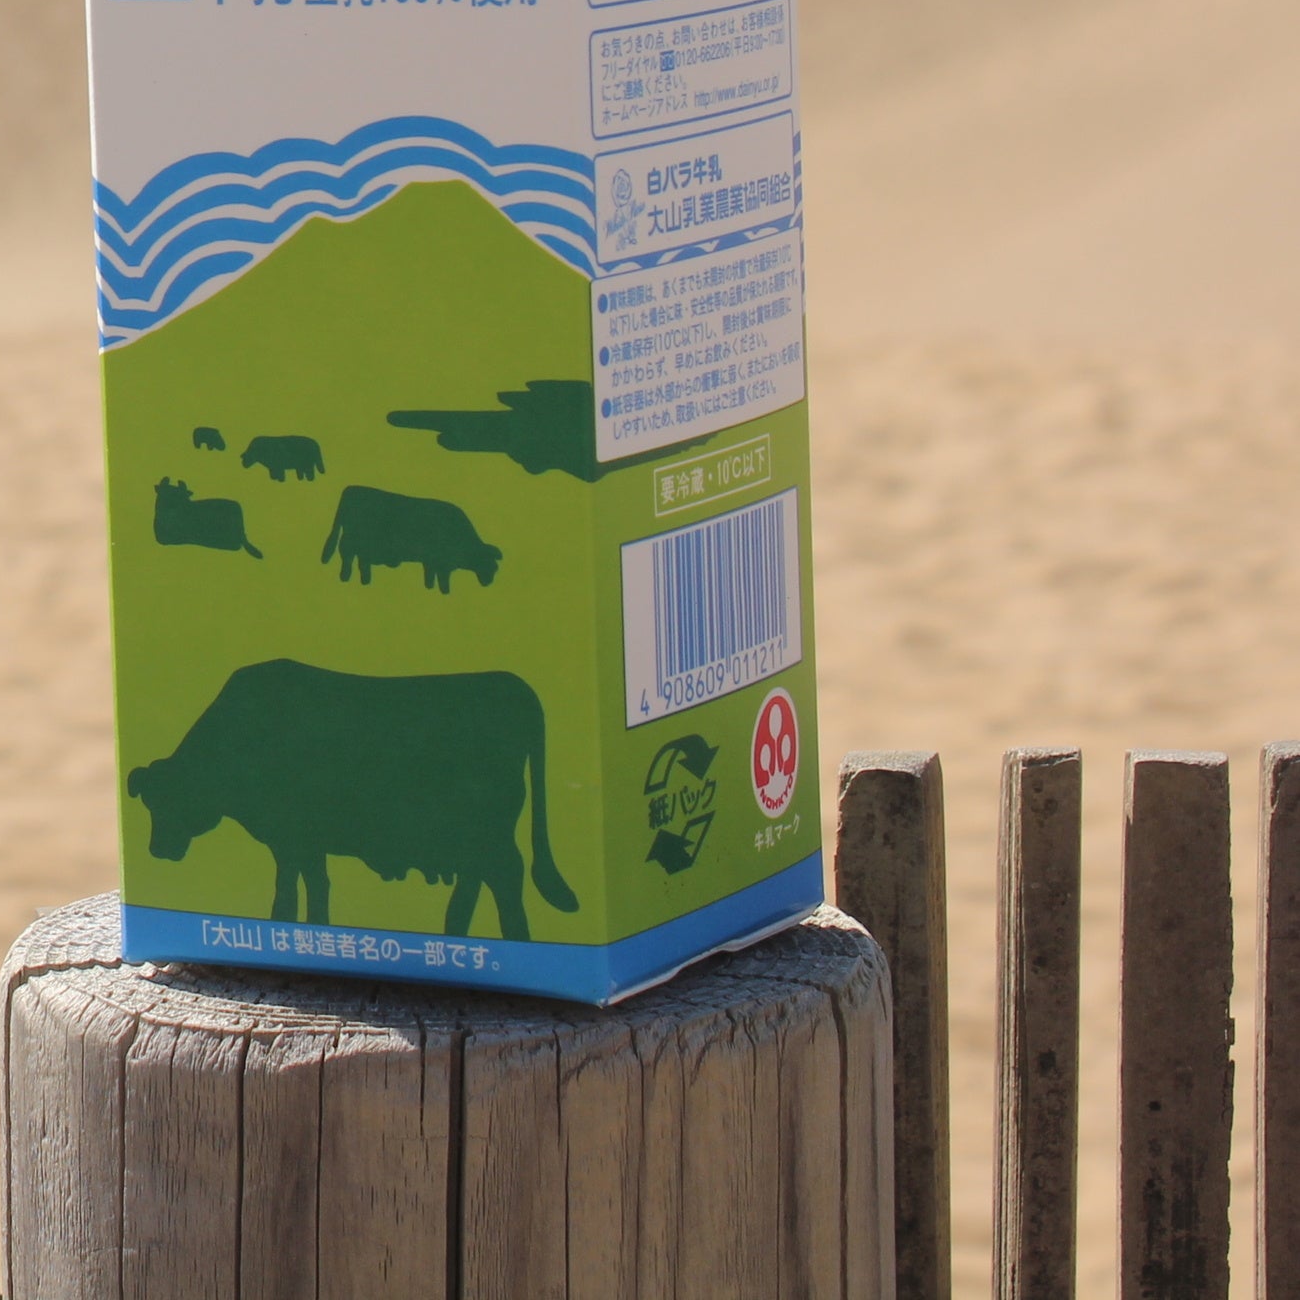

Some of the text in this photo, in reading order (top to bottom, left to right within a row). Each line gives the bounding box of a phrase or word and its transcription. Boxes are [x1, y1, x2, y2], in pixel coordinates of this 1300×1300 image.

[647, 154, 723, 196] 白バラ牛乳
[647, 171, 791, 237] 大山乳業農業協同組合
[640, 688, 649, 716] 4
[663, 663, 725, 710] 908609
[649, 779, 716, 830] 紙パック
[755, 814, 799, 851] 牛乳マーク
[202, 920, 501, 971] 「大山」は製造者名の一部です。
